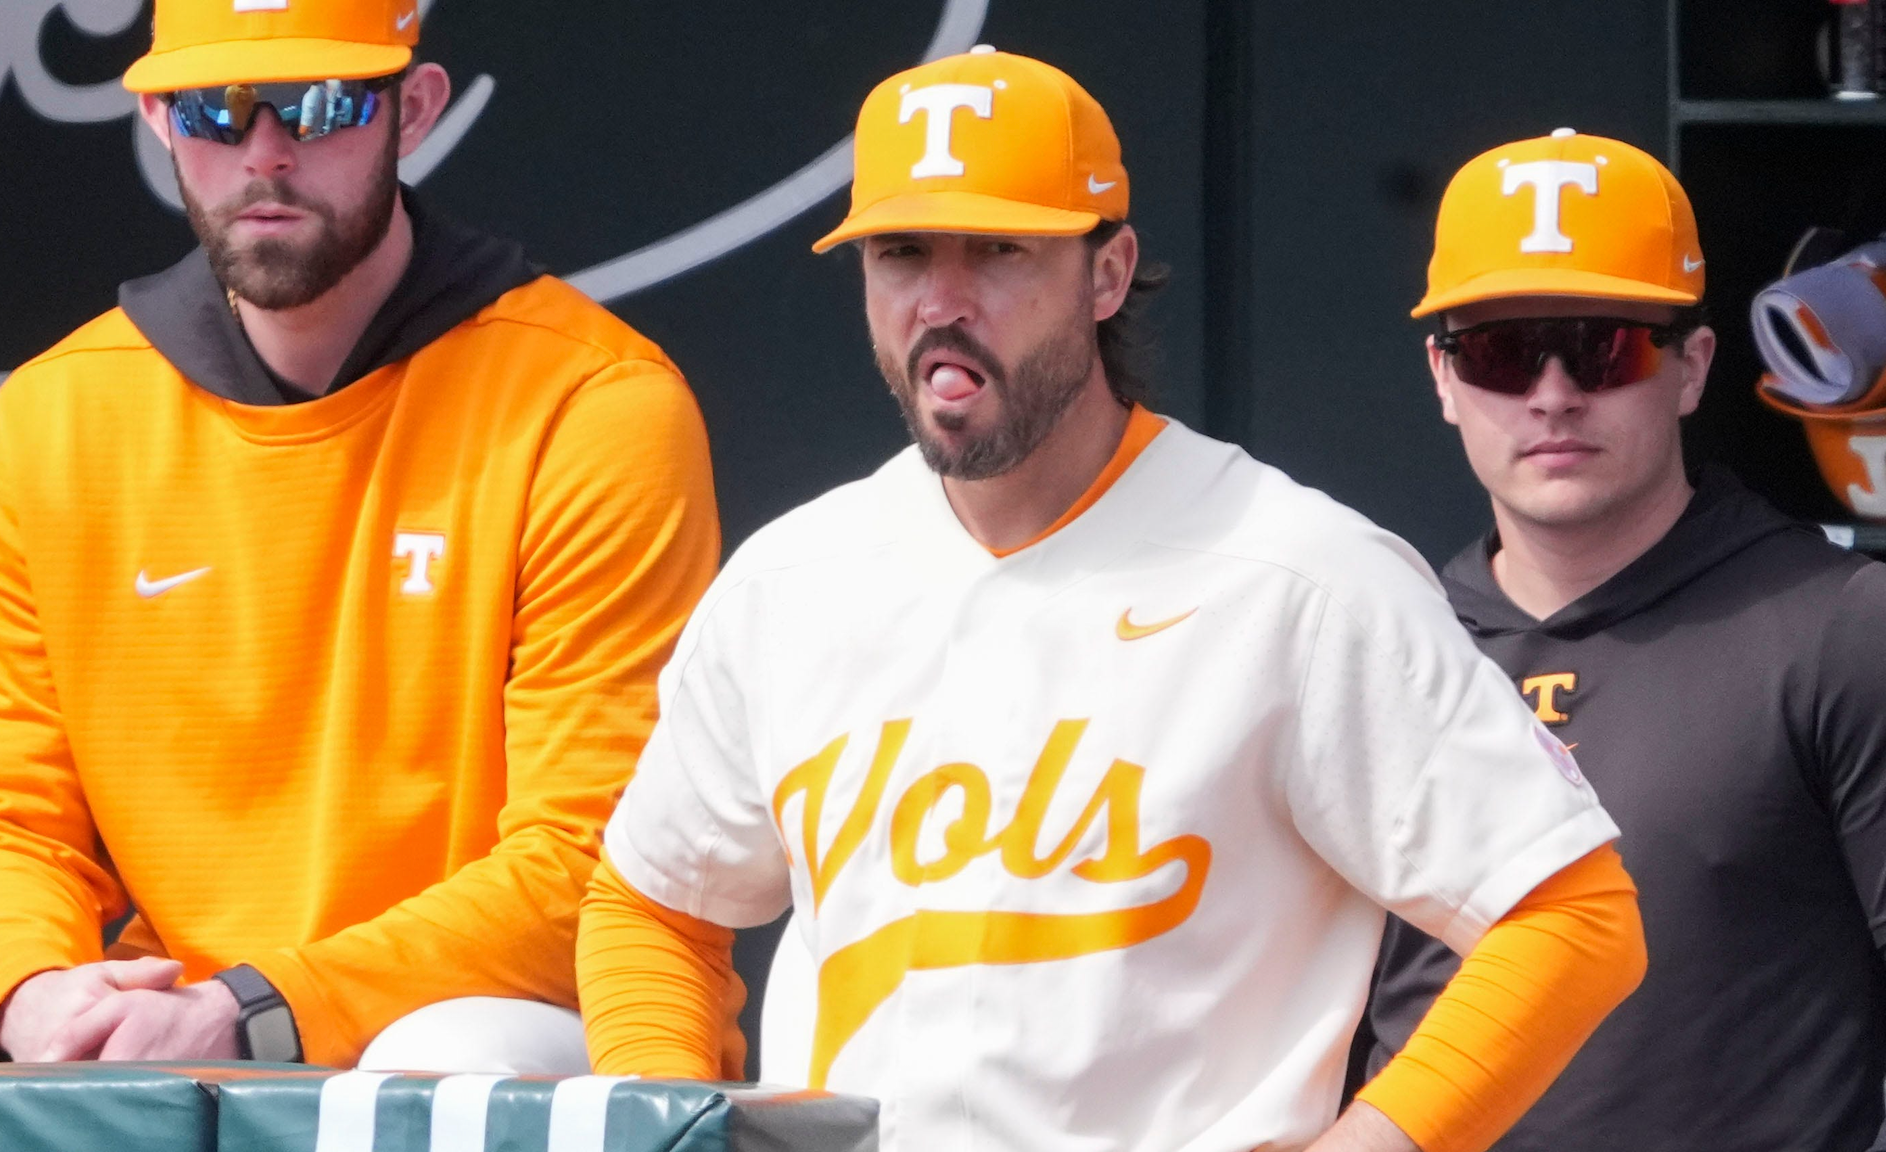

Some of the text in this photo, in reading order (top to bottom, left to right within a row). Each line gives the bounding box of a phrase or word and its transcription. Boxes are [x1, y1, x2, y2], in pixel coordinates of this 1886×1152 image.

[898, 83, 994, 180] T
[1502, 160, 1598, 253] T
[394, 532, 445, 594] T
[1522, 672, 1575, 722] T
[772, 717, 1213, 920] Vols
